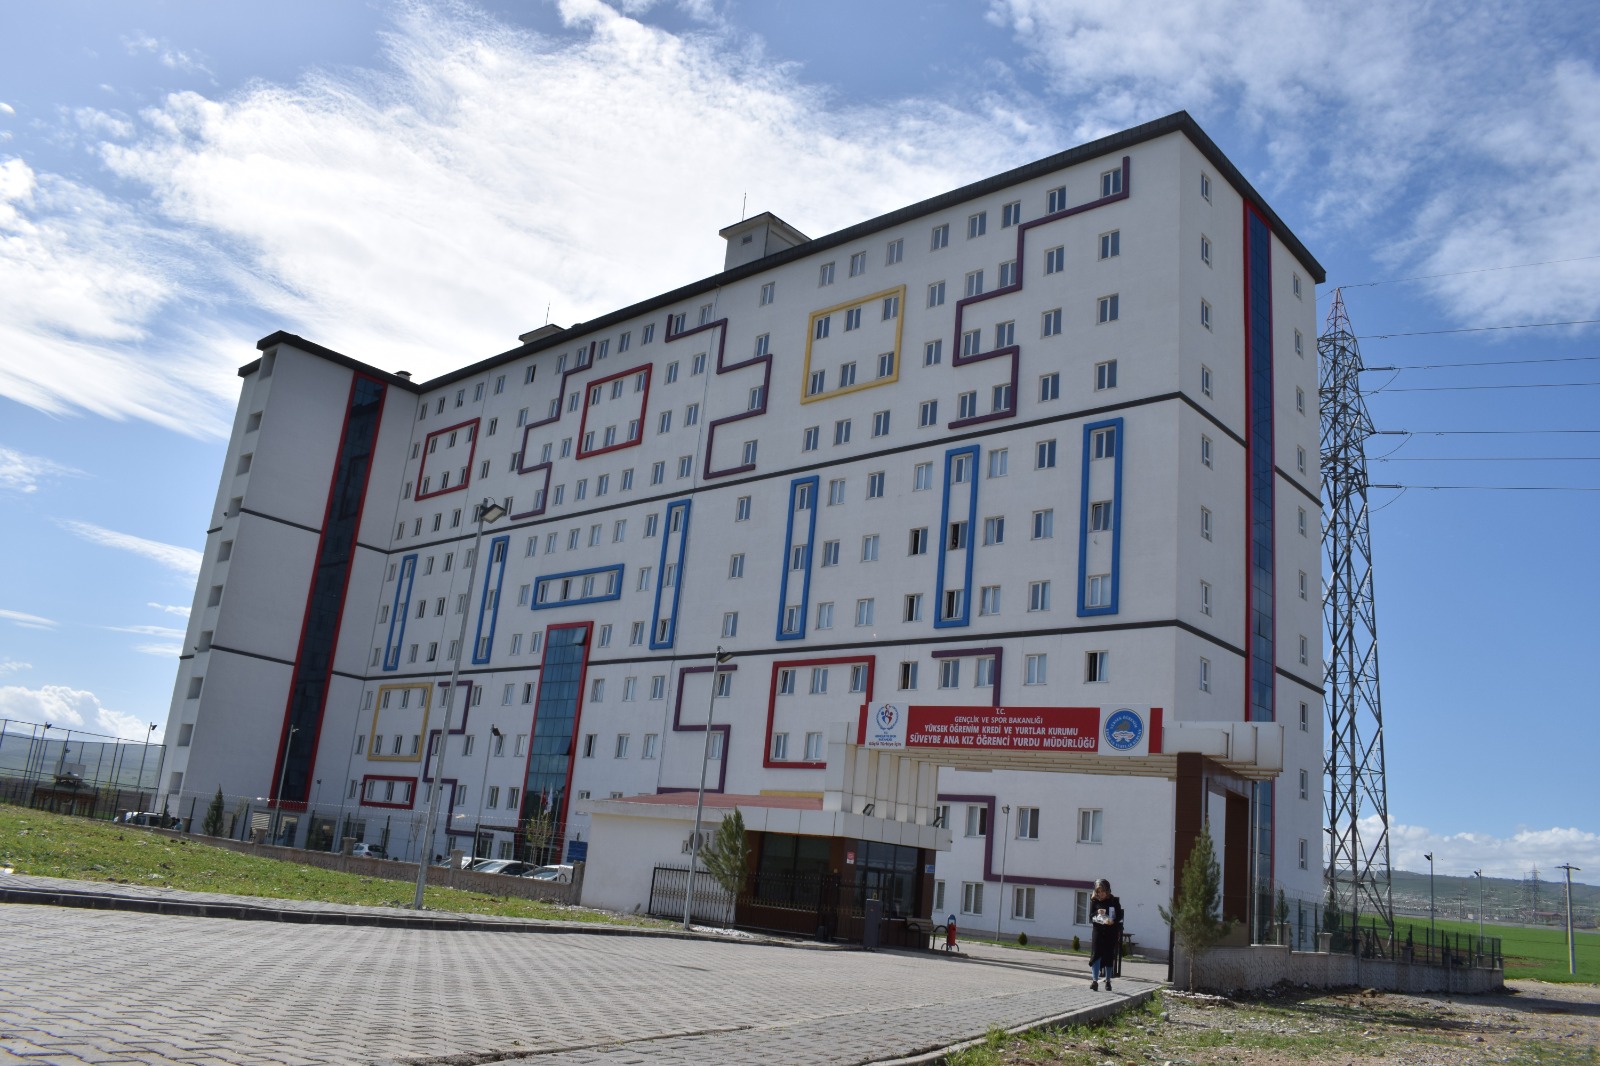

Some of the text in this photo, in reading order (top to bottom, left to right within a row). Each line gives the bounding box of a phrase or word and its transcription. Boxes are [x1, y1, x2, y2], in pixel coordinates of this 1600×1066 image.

[954, 716, 980, 724] GENÇLİK
[1008, 716, 1043, 724] BAKANLIĞI
[924, 723, 1079, 736] YÜKSEK ÖĞRENİM KREDİ VE YURTLAR KURUMU
[909, 732, 942, 743] SÜVEYBE
[943, 735, 960, 744] ANA
[961, 735, 974, 745] KIZ
[976, 734, 1010, 746] ÖĞRENCİ
[1013, 737, 1040, 747] YURDU
[1043, 736, 1095, 748] MÜDÜRLÜĞÜ
